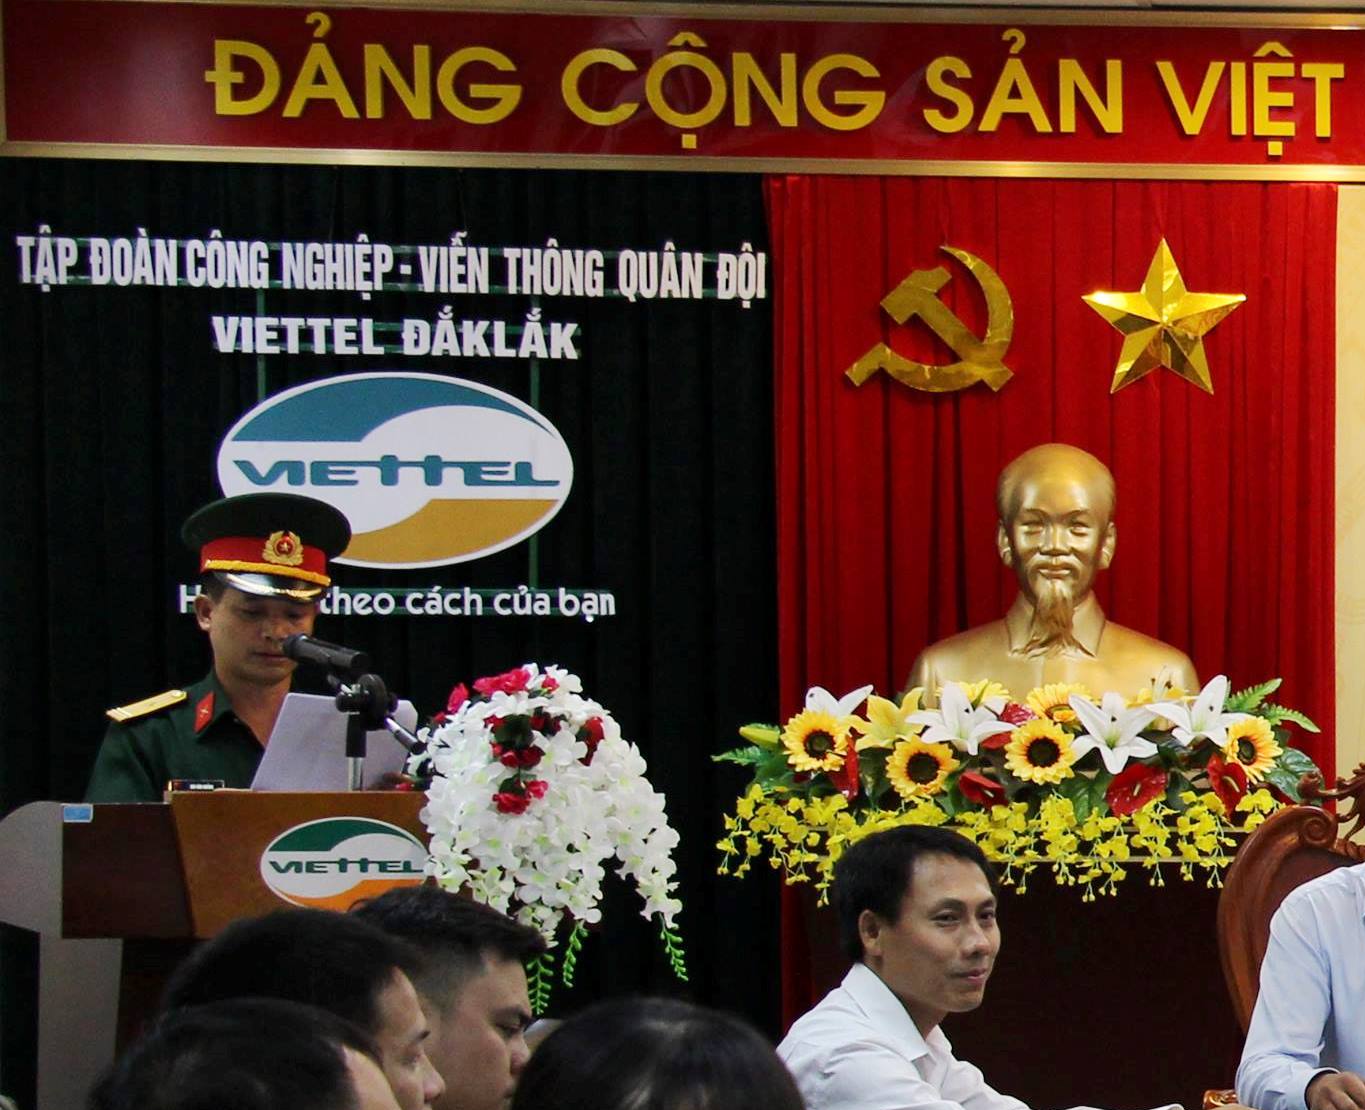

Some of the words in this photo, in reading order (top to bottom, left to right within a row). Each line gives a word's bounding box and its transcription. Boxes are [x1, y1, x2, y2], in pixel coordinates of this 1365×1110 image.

[205, 13, 522, 125] ĐẢNG
[561, 33, 886, 149] CỘNG
[923, 28, 1124, 134] SẢN
[1156, 42, 1344, 156] VIỆT
[16, 224, 79, 292] TẬP
[89, 227, 178, 286] ĐOÀN
[186, 229, 270, 289] CÔNG
[282, 233, 394, 300] NGHIỆP
[418, 231, 489, 294] VIỄN
[504, 238, 605, 297] THÔNG
[618, 241, 703, 302] QUÂN
[717, 242, 766, 308] ĐỘI
[212, 316, 384, 354] VIETTEL
[320, 586, 396, 616] theo
[405, 586, 483, 616] cách
[493, 585, 551, 617] của
[558, 588, 616, 623] bạn
